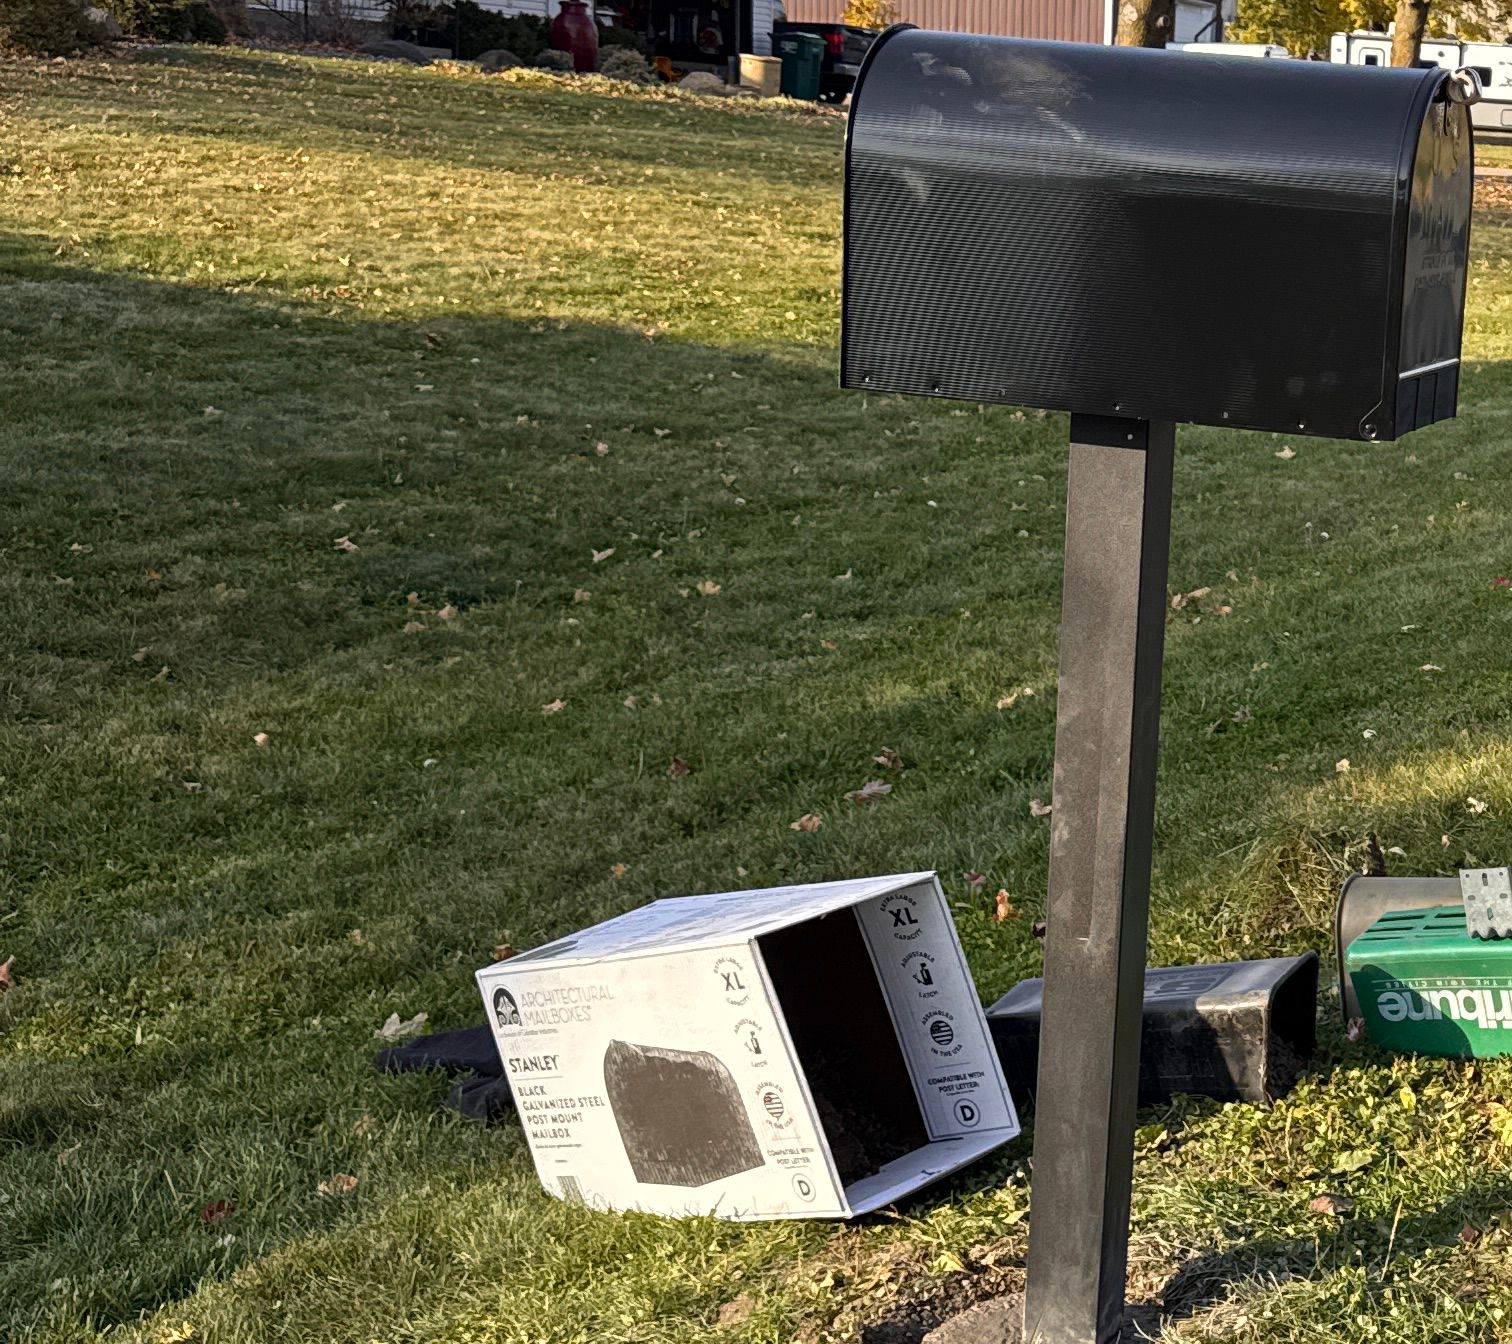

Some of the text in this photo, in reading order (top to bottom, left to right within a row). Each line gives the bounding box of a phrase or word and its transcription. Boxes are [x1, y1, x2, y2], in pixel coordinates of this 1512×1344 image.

[889, 907, 919, 927] XL
[894, 928, 922, 940] CAPACITY
[721, 971, 745, 991] XL
[521, 985, 615, 1008] ARCHITECTURAL
[921, 1010, 954, 1026] ASSEMBLED
[509, 1055, 560, 1073] STANLEY
[517, 1085, 547, 1097] BLACK
[522, 1095, 605, 1111] GALVANIZED STEEL
[527, 1112, 583, 1125] POST MOUNT
[960, 1105, 975, 1122] D
[532, 1127, 571, 1139] MAILBOX
[797, 1180, 810, 1196] D
